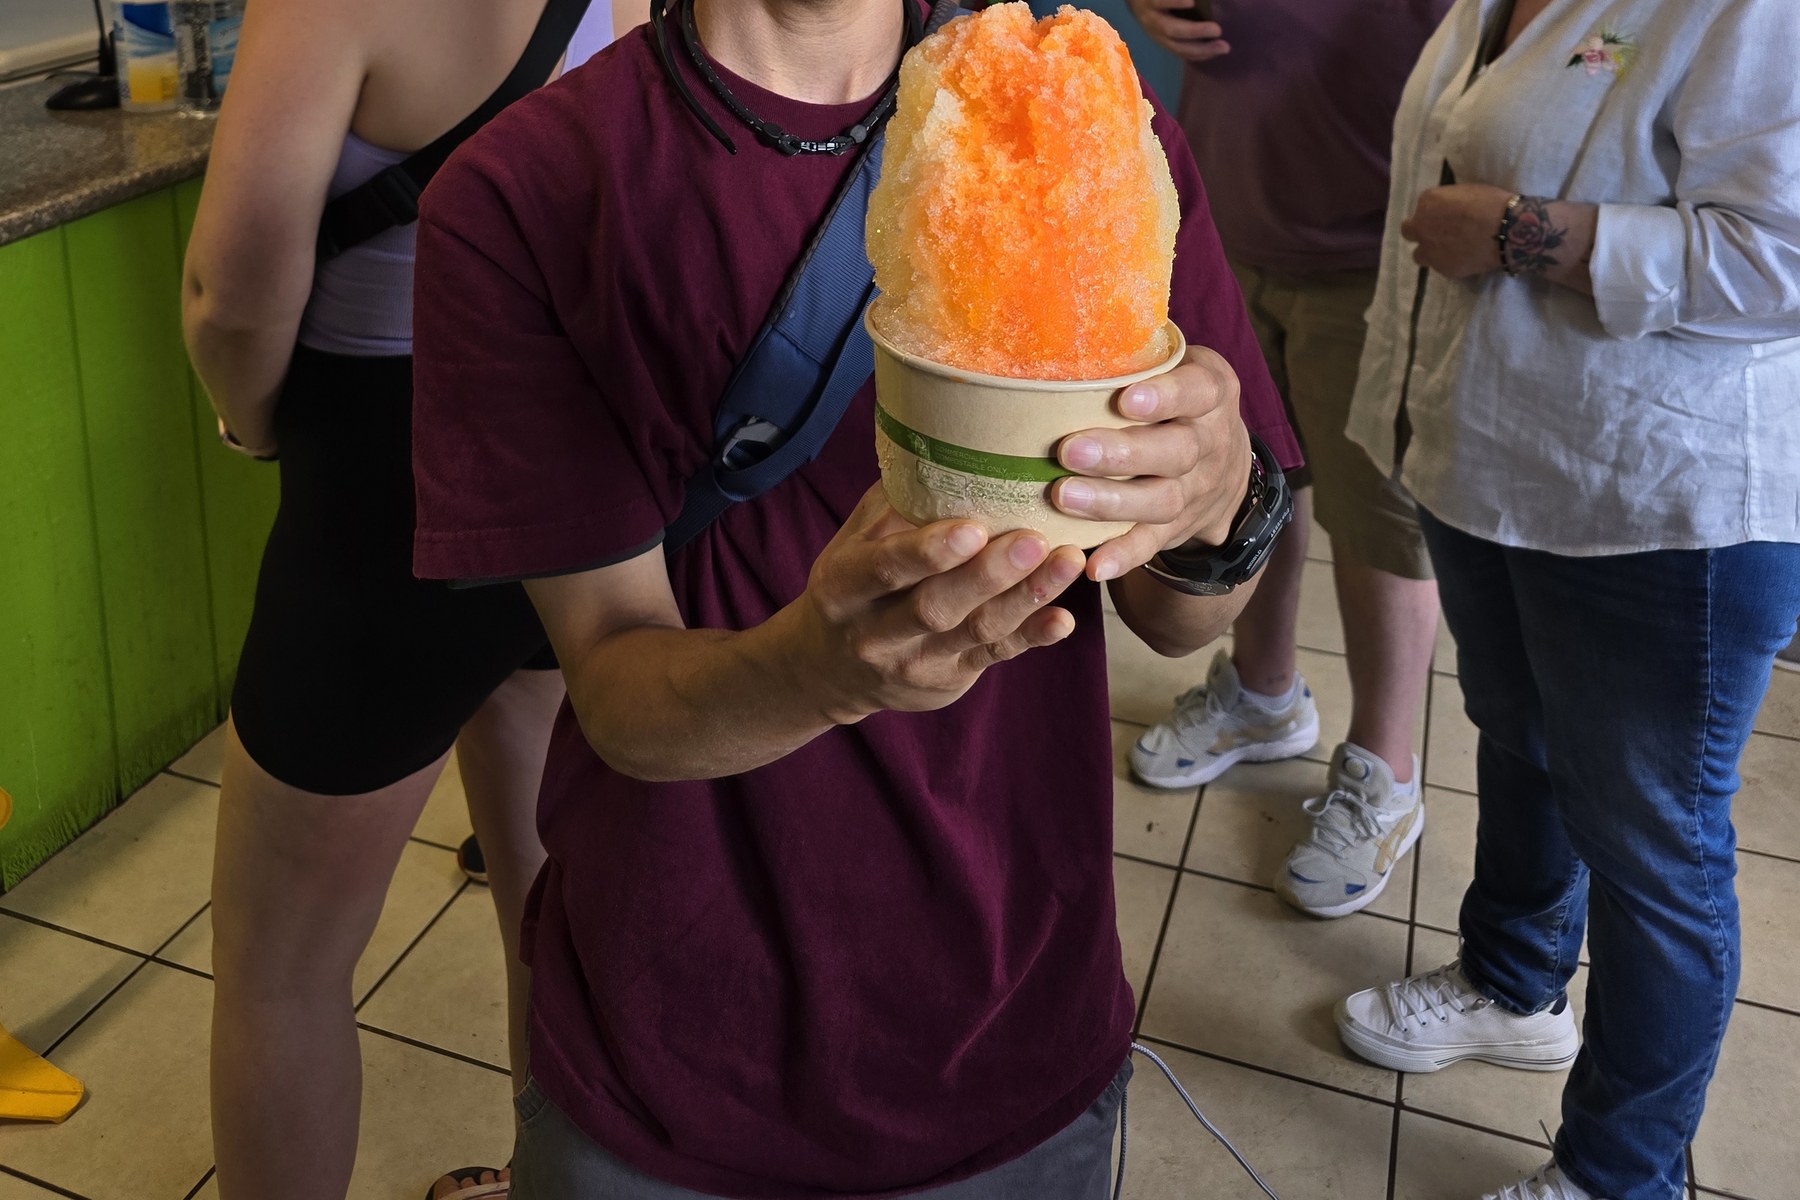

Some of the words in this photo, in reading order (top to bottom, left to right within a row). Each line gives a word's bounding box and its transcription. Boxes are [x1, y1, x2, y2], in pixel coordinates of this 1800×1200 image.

[935, 446, 989, 463] COMMERCIALLY
[935, 453, 986, 471] COMPOSTABLE
[987, 465, 1008, 474] ONLY
